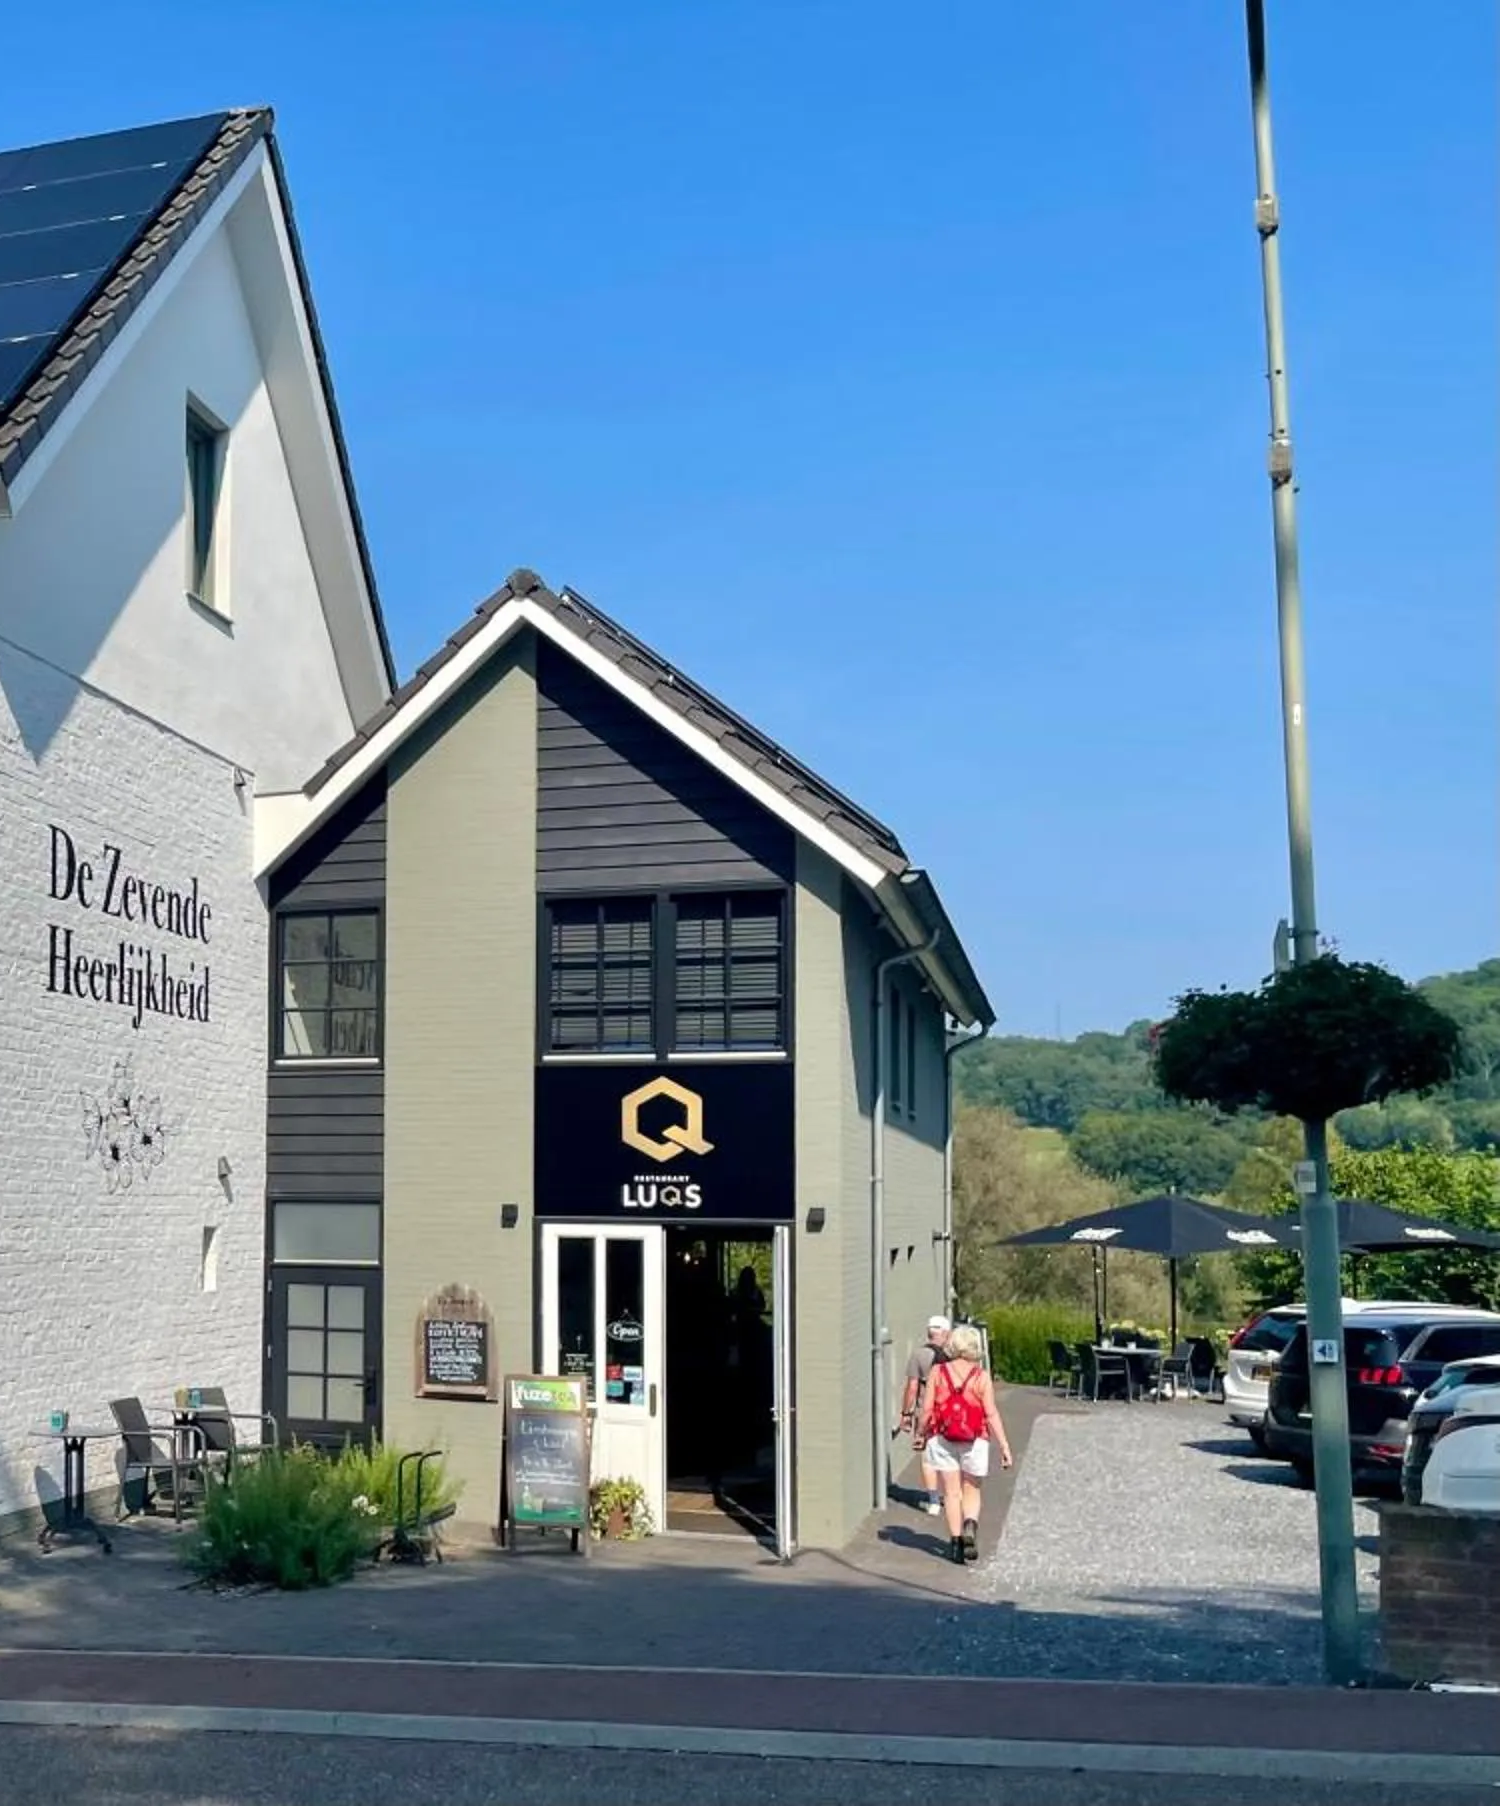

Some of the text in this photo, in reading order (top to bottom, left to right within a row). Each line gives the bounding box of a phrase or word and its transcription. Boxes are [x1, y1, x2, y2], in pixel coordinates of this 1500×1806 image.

[47, 824, 211, 944] De Zevende
[46, 923, 210, 1030] Heerlijkheid
[622, 1183, 703, 1208] LUQS
[612, 1322, 640, 1341] Open
